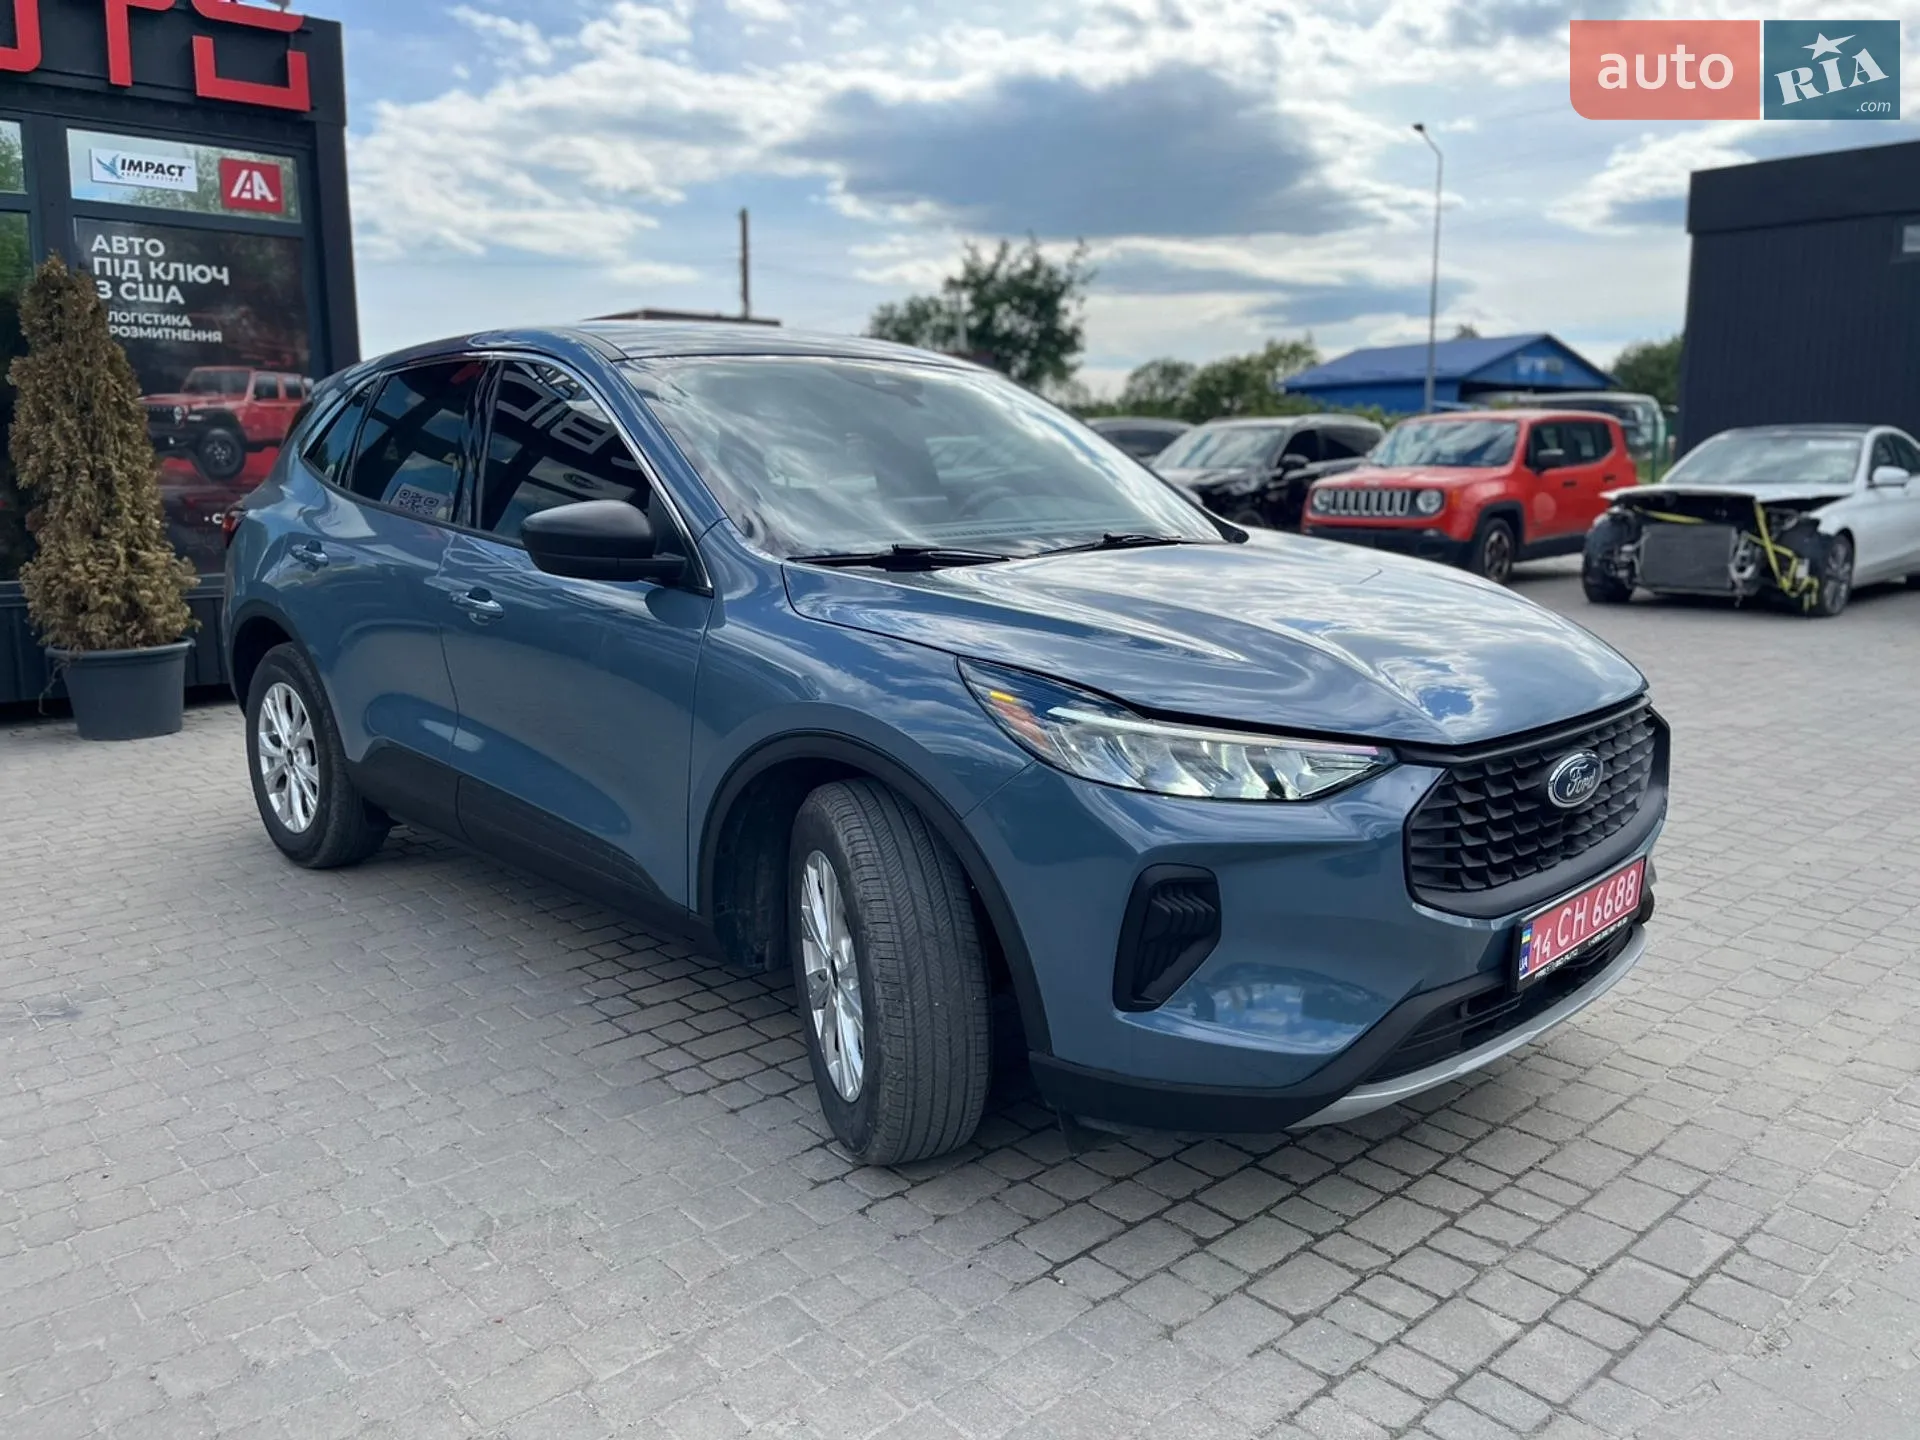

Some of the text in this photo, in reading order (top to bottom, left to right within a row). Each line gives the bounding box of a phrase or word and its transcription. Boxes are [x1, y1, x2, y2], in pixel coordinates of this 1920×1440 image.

[120, 157, 187, 178] IMPACT
[91, 234, 165, 258] АВТО
[93, 256, 230, 286] ПІД КЛЮЧ
[96, 280, 186, 305] З США
[108, 311, 193, 327] ЛОГІСТИКА
[109, 325, 223, 343] РОЗМИТНЕННЯ
[1566, 763, 1596, 798] Ford
[1533, 928, 1552, 964] 14
[1557, 896, 1588, 947] CH
[1592, 869, 1636, 927] 6688
